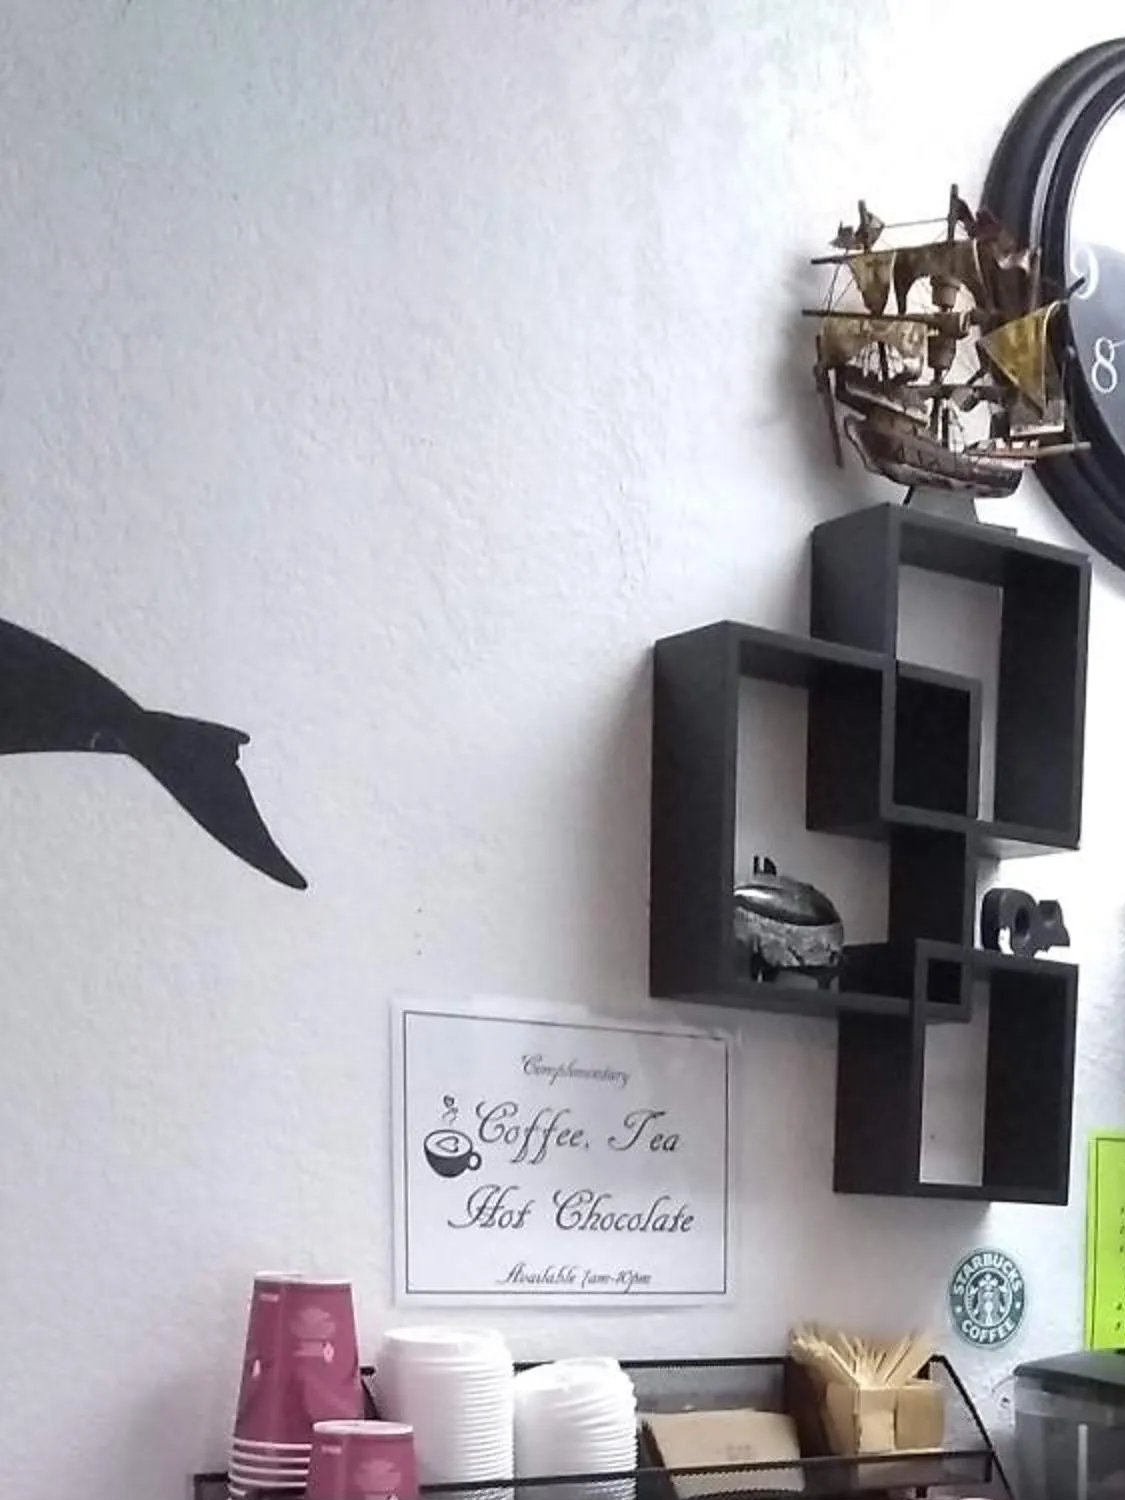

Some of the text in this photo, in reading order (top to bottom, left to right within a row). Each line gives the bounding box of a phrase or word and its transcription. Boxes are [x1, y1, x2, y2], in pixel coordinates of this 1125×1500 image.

[1091, 336, 1119, 394] 8
[520, 1053, 631, 1088] Complimentary
[608, 1109, 681, 1152] Tea
[447, 1184, 695, 1233] Hot Chocolate
[495, 1261, 577, 1285] Available
[953, 1253, 1022, 1295] STARBUCKS
[961, 1318, 1015, 1343] COFFEE
